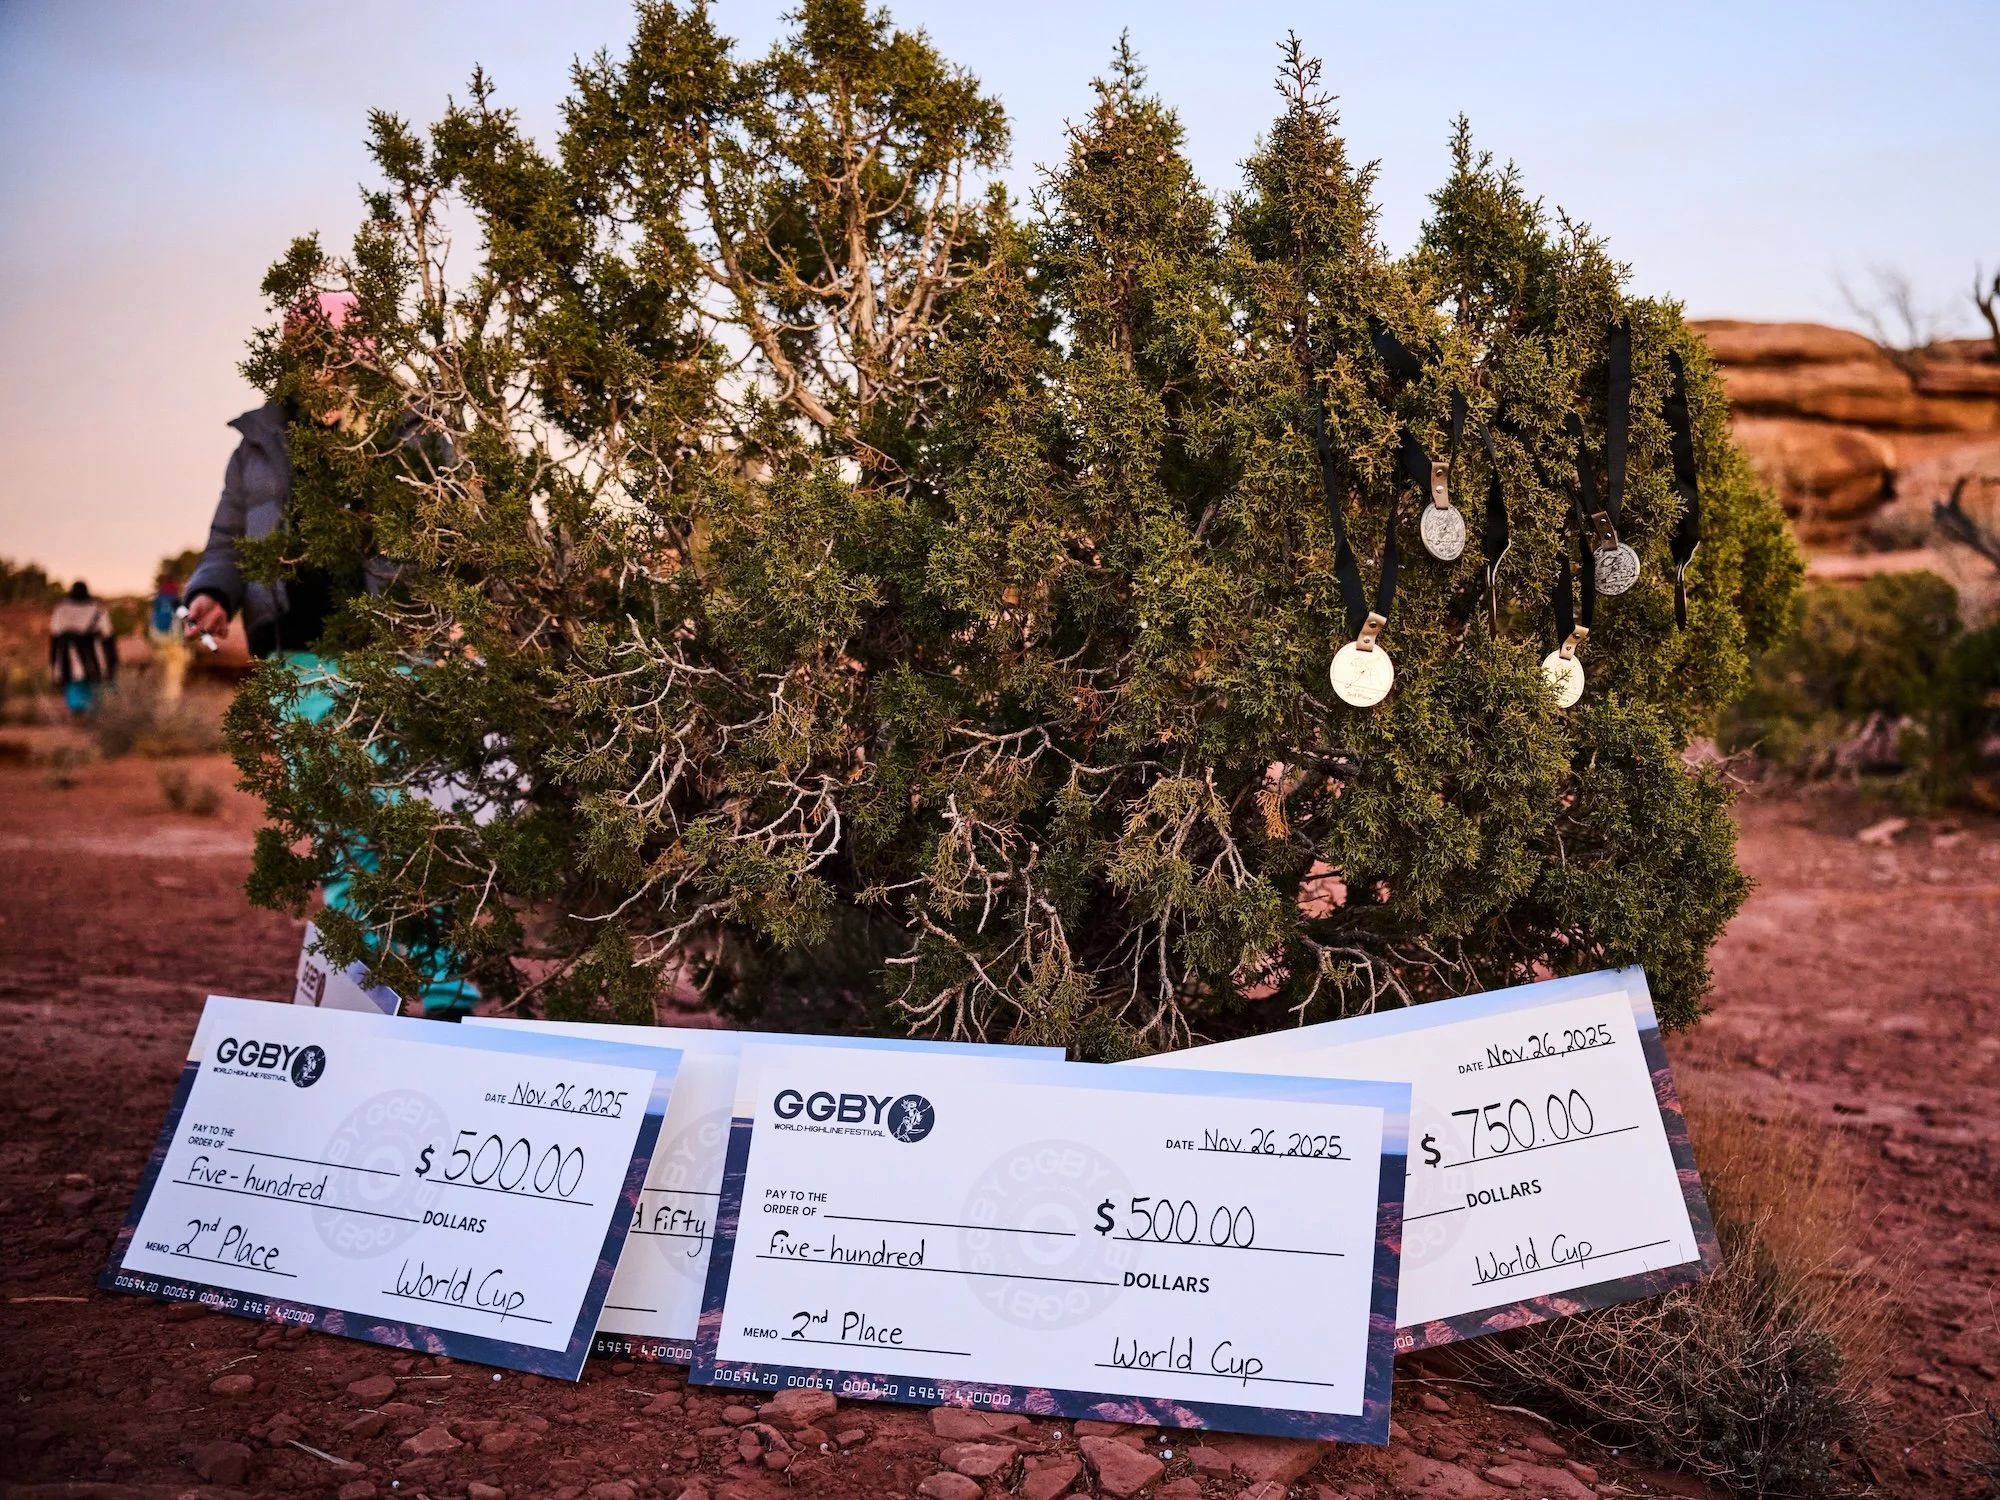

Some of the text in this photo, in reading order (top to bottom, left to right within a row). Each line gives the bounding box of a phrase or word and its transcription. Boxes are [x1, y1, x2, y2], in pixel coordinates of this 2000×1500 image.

[216, 1037, 301, 1071] GGBY
[1458, 1062, 1484, 1075] DATE
[213, 1067, 233, 1075] WORLD
[260, 1073, 288, 1082] FESTIVAL
[484, 1092, 507, 1104] DATE
[773, 1089, 894, 1125] GGBY
[187, 1136, 225, 1148] ORDER OF
[192, 1123, 236, 1138] PAY TO THE
[773, 1123, 886, 1138] WORLD HIGHLINE FESTIVAL
[1420, 1088, 1594, 1168] $ 750.00
[1165, 1139, 1195, 1151] DATE
[414, 1129, 585, 1197] $ 500.00
[765, 1189, 828, 1203] PAY TO THE
[1466, 1179, 1543, 1209] DOLLARS
[422, 1210, 487, 1234] DOLLARS
[763, 1203, 817, 1216] ORDER OF
[1093, 1197, 1255, 1248] $ 500.00
[145, 1217, 280, 1271] MEMO 2nd Place
[1475, 1234, 1593, 1283] World Cup
[397, 1259, 525, 1323] World Cup
[1123, 1271, 1210, 1294] DOLLARS
[114, 1275, 315, 1324] 0069420 00069 000420 6969 420000
[742, 1309, 904, 1345] MEMO 2nd Place
[641, 1344, 693, 1360] 420000
[1112, 1336, 1263, 1388] World Cup
[714, 1368, 1011, 1406] 0069420 00069 000420 6969 420000
